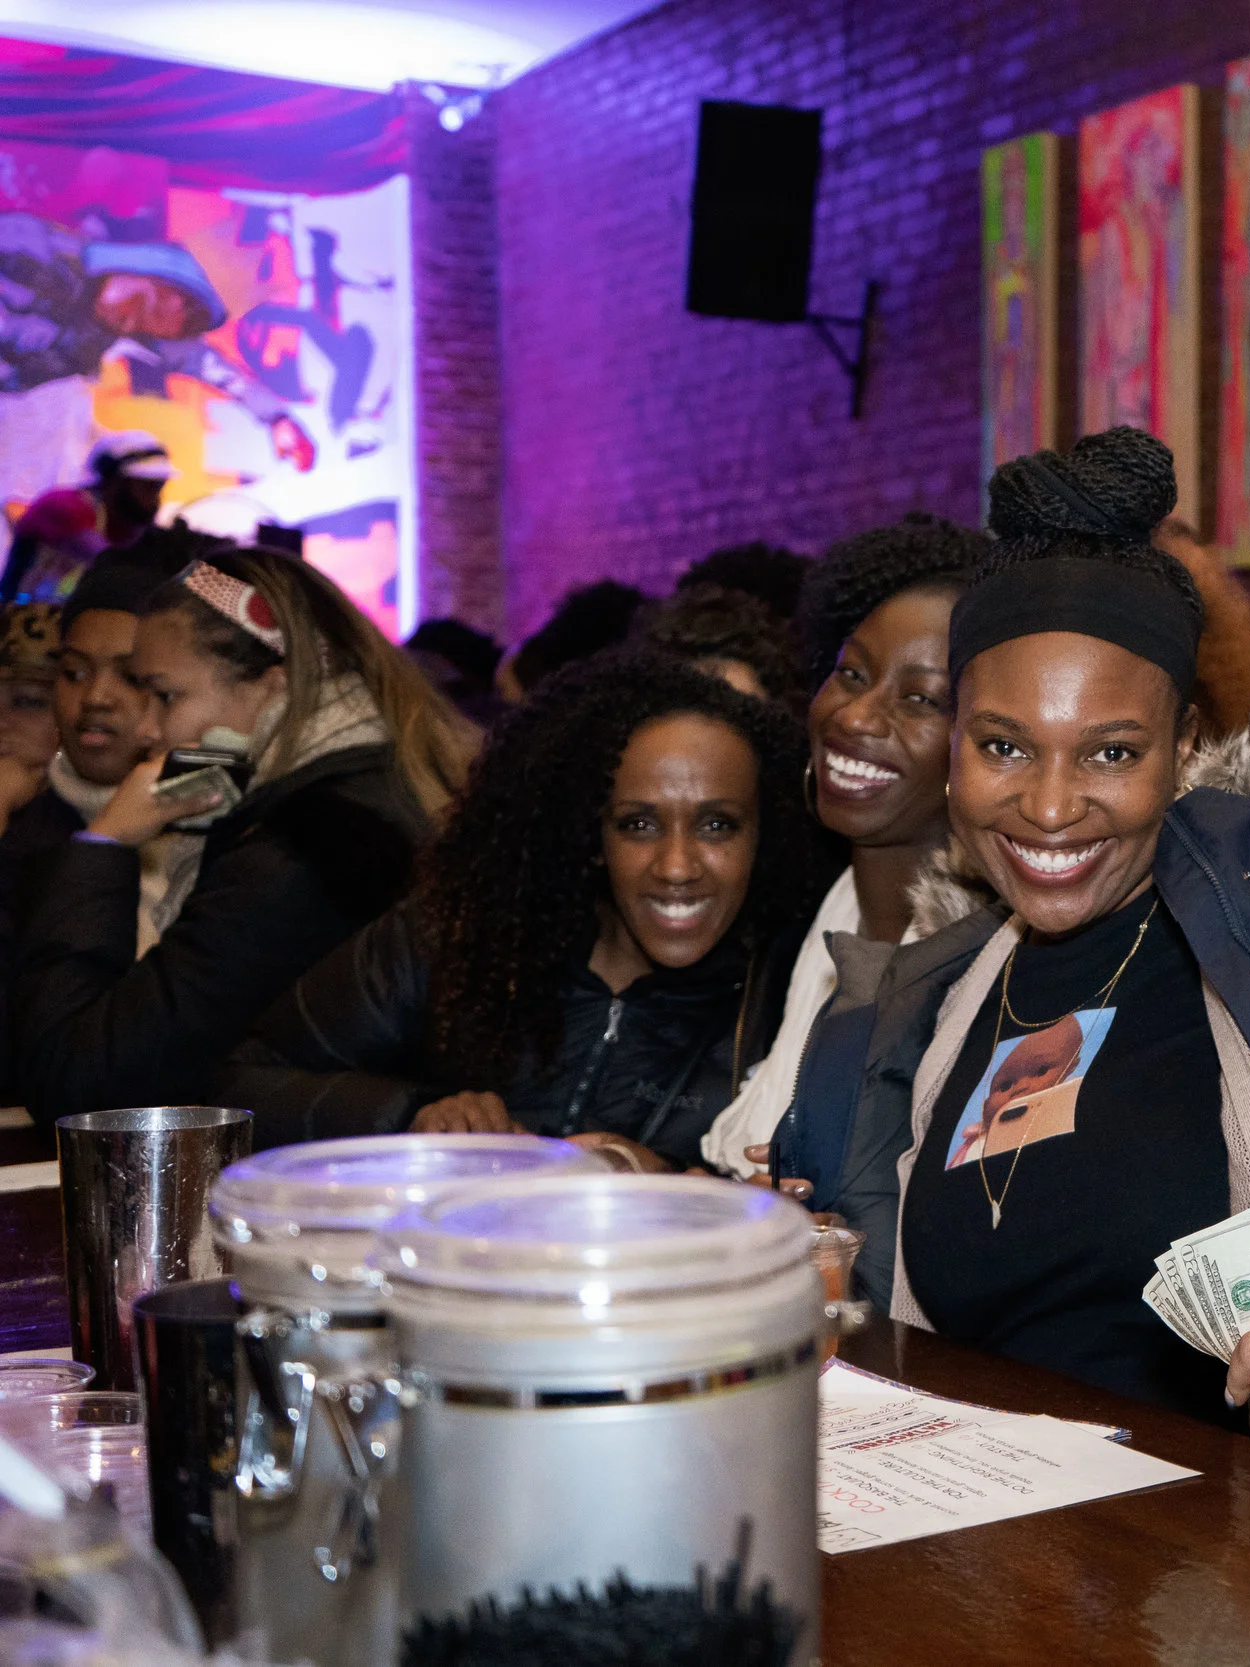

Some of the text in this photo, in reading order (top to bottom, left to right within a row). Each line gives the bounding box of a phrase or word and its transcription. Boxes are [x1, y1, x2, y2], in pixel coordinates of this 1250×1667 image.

[1179, 1243, 1200, 1276] 20
[1163, 1258, 1183, 1290] 20
[850, 1421, 953, 1450] BROOKLYN
[878, 1461, 926, 1481] CULTURE
[920, 1479, 946, 1490] THE
[1012, 1486, 1034, 1495] DO
[884, 1495, 908, 1506] THE
[942, 1488, 968, 1500] FOR
